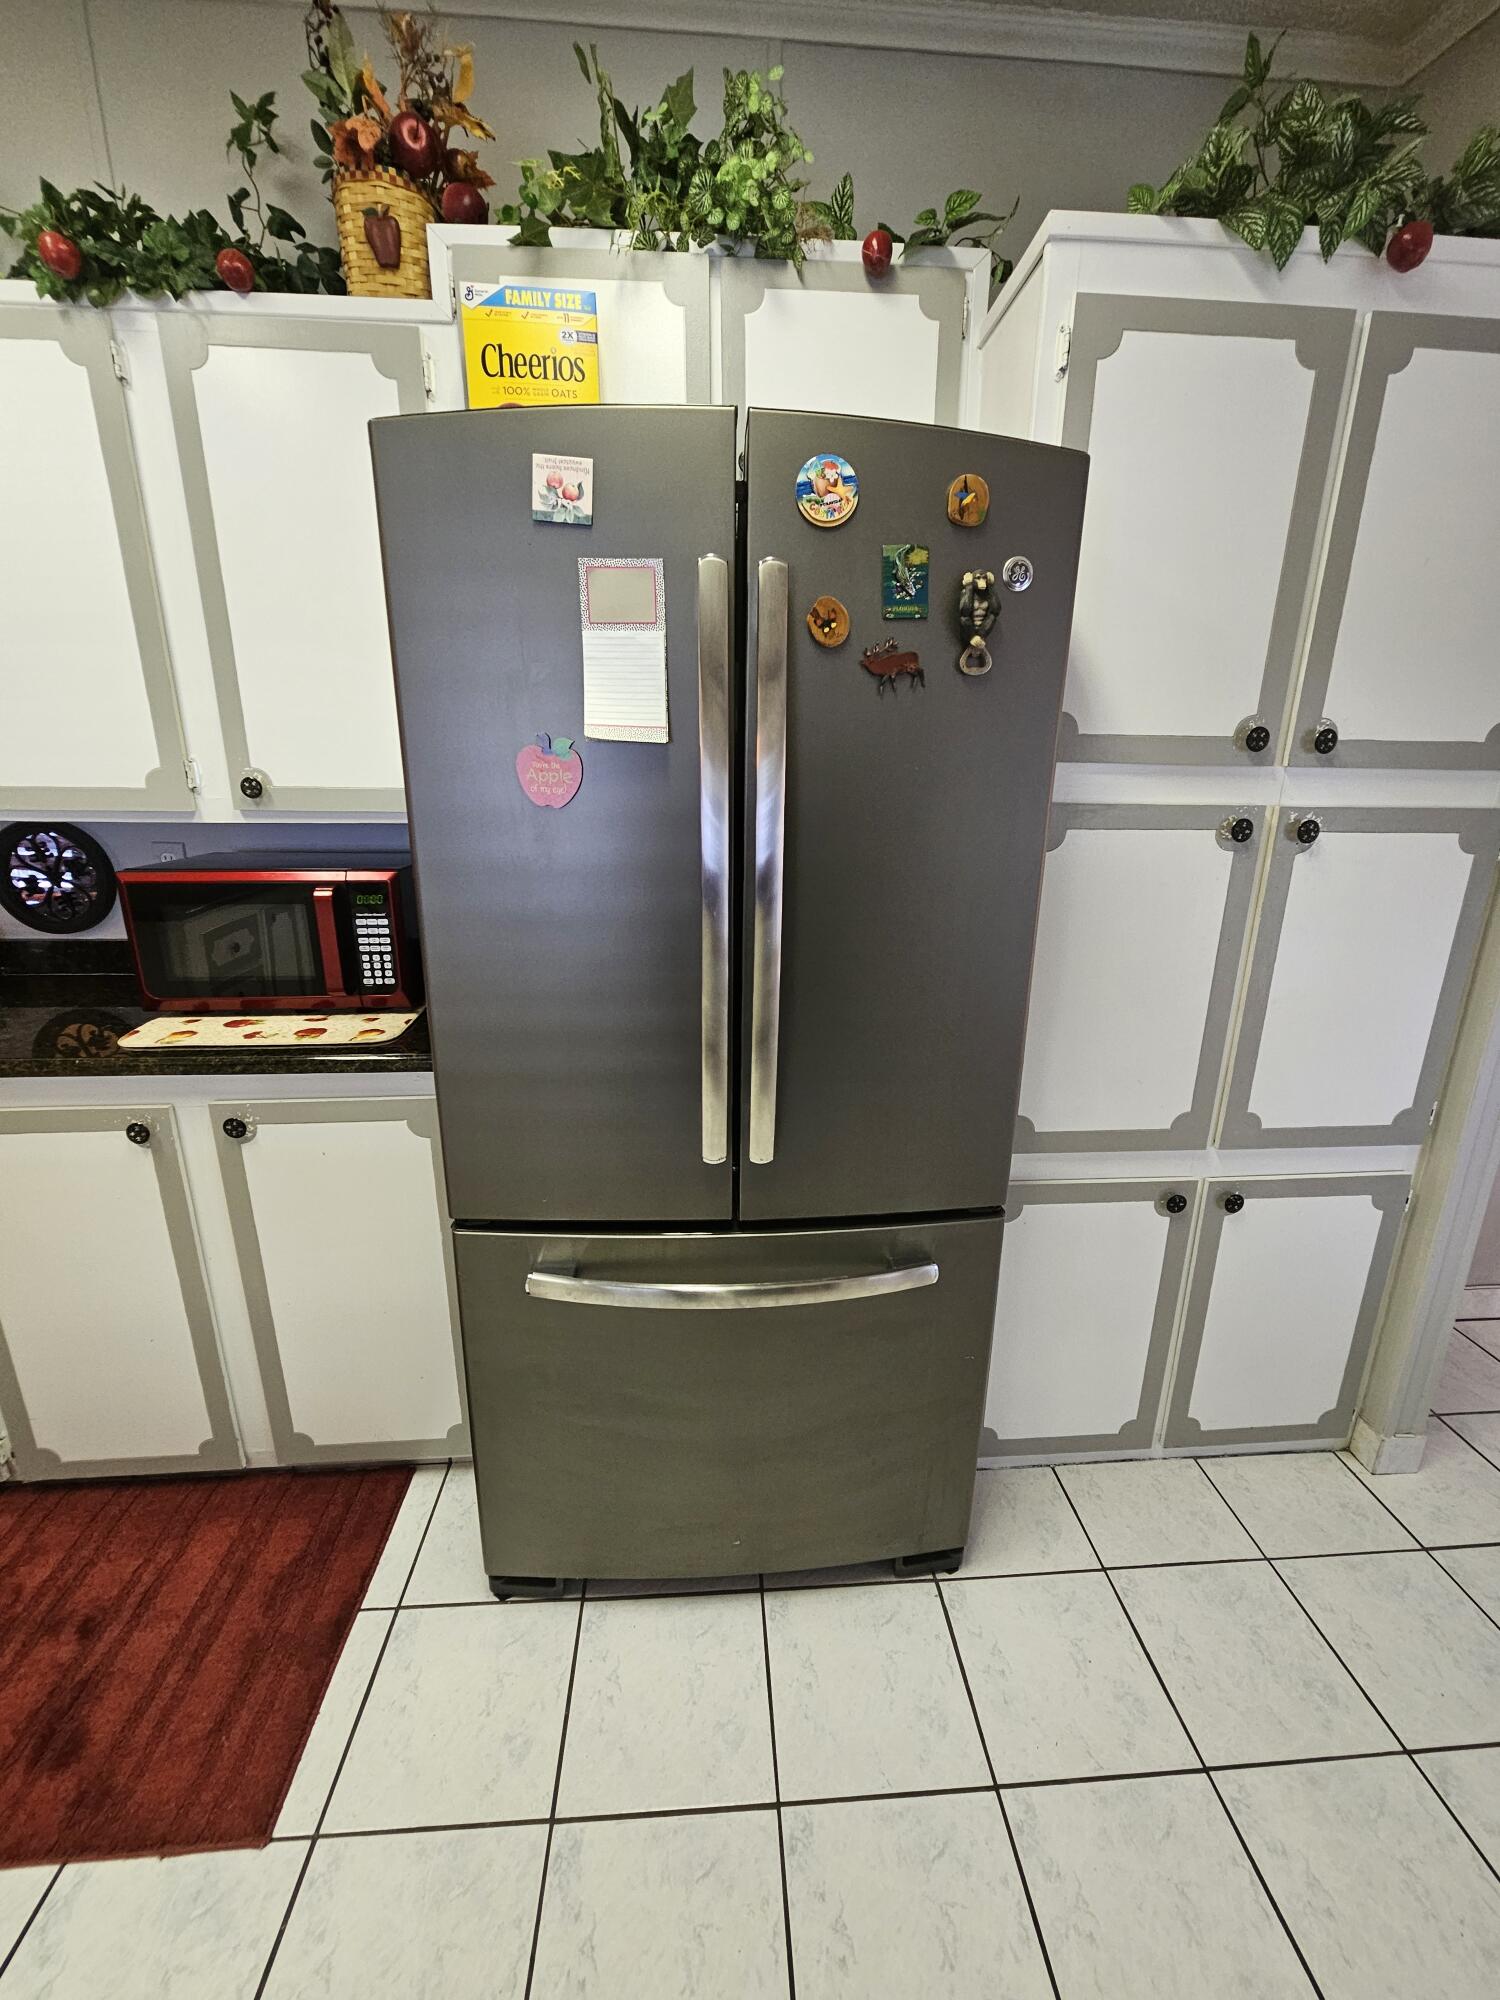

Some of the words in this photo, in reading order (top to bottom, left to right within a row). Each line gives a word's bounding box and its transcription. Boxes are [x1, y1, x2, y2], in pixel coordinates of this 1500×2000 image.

[505, 288, 551, 307] FAMILY
[554, 292, 582, 310] SIZE
[561, 331, 574, 340] 2X
[481, 343, 586, 383] Cheerios
[503, 386, 531, 397] 100%
[551, 388, 578, 399] OATS
[528, 768, 573, 785] Apple
[530, 784, 538, 792] of
[541, 786, 551, 794] my
